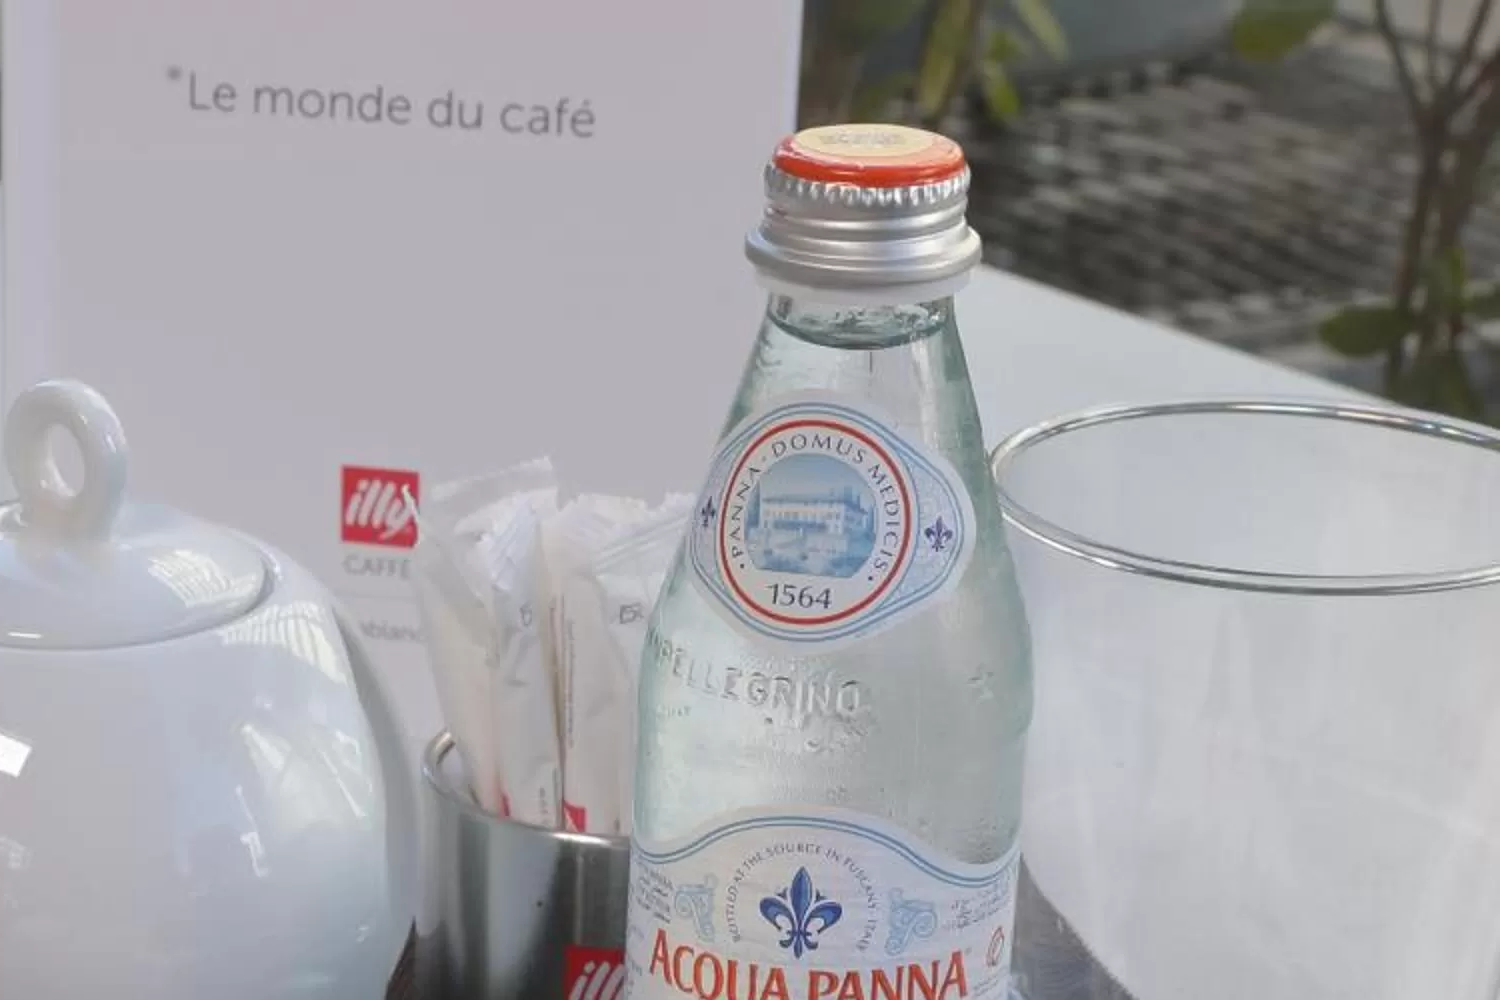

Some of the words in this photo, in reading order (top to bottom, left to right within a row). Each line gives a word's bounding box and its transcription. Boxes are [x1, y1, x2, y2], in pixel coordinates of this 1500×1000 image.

[253, 84, 412, 125] monde
[427, 90, 484, 130] du
[498, 98, 597, 139] café
[345, 478, 417, 542] illy
[729, 466, 762, 560] PANNA
[771, 433, 867, 465] DOMUS
[867, 463, 901, 574] MEDICIS
[766, 582, 833, 610] 1564
